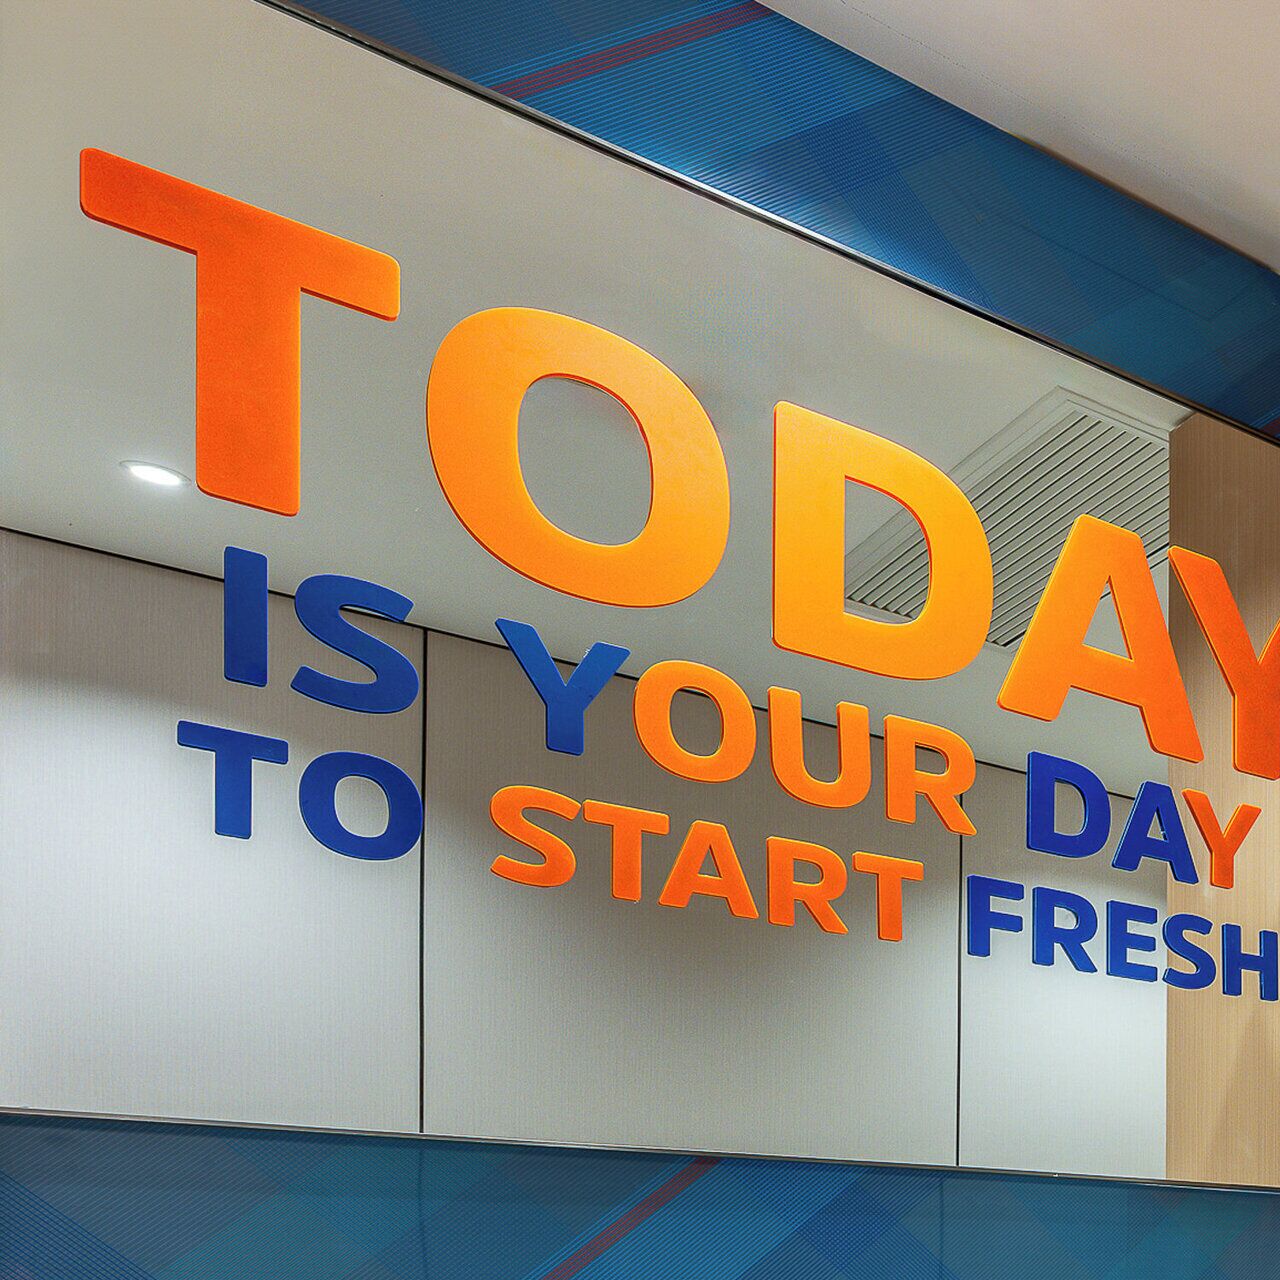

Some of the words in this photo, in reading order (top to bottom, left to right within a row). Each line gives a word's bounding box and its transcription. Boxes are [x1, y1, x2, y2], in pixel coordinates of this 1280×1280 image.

[177, 720, 425, 862] TO
[489, 785, 924, 942] START
[966, 874, 1280, 1002] FRESH
[223, 546, 420, 715] IS
[494, 617, 977, 837] YOUR
[1026, 750, 1261, 890] DAY
